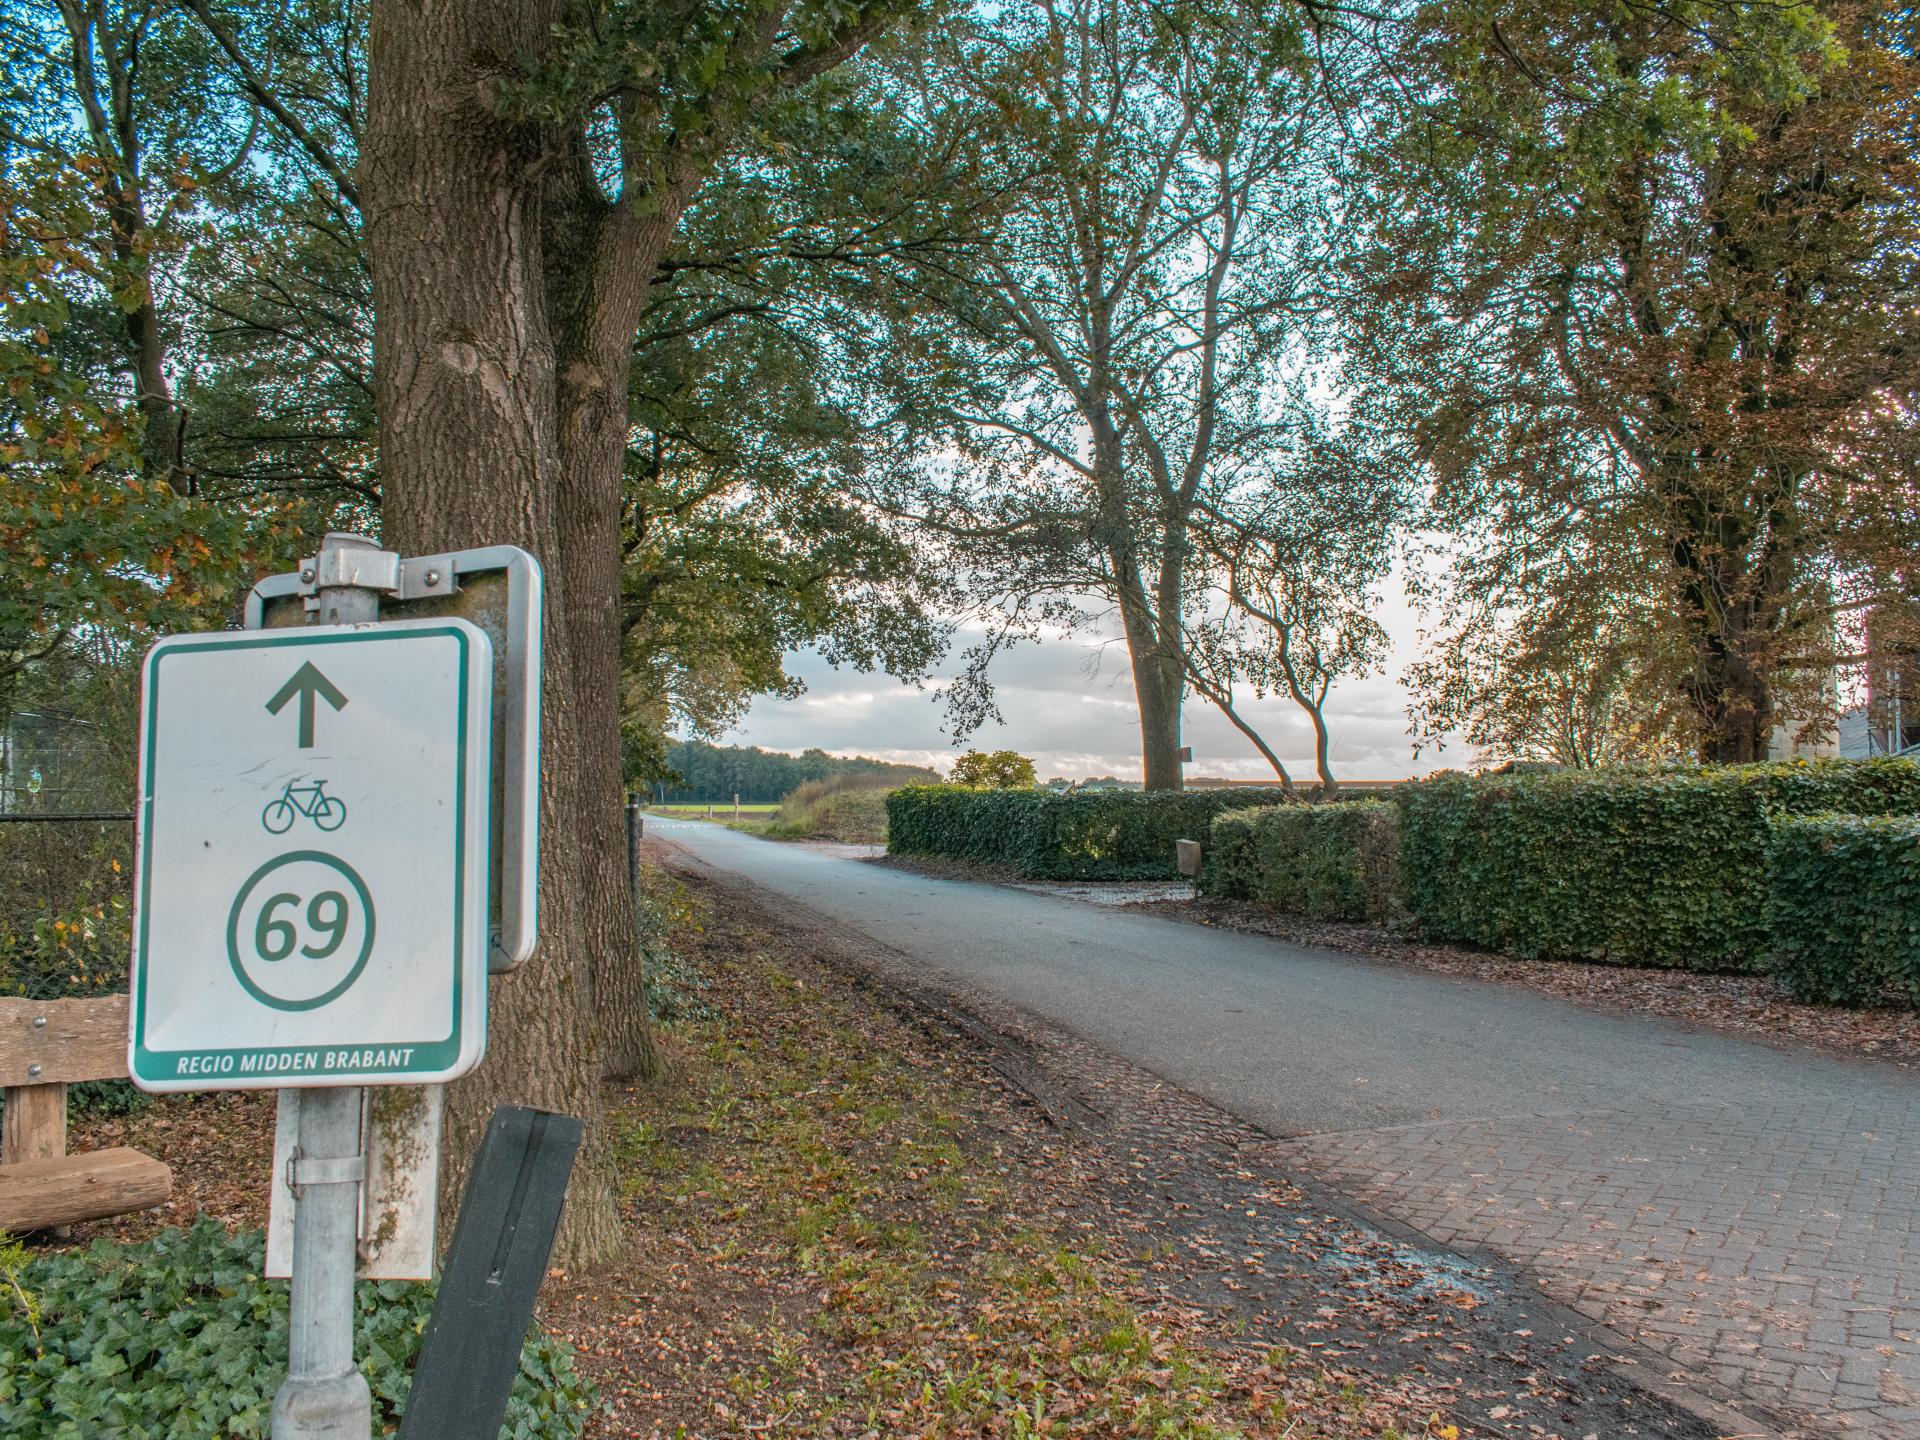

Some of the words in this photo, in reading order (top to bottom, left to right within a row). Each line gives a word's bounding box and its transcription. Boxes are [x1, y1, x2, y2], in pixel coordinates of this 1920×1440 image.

[255, 890, 349, 961] 69
[177, 1056, 233, 1074] REGIO
[240, 1053, 318, 1072] MIDDEN
[324, 1049, 414, 1069] BRABANT
